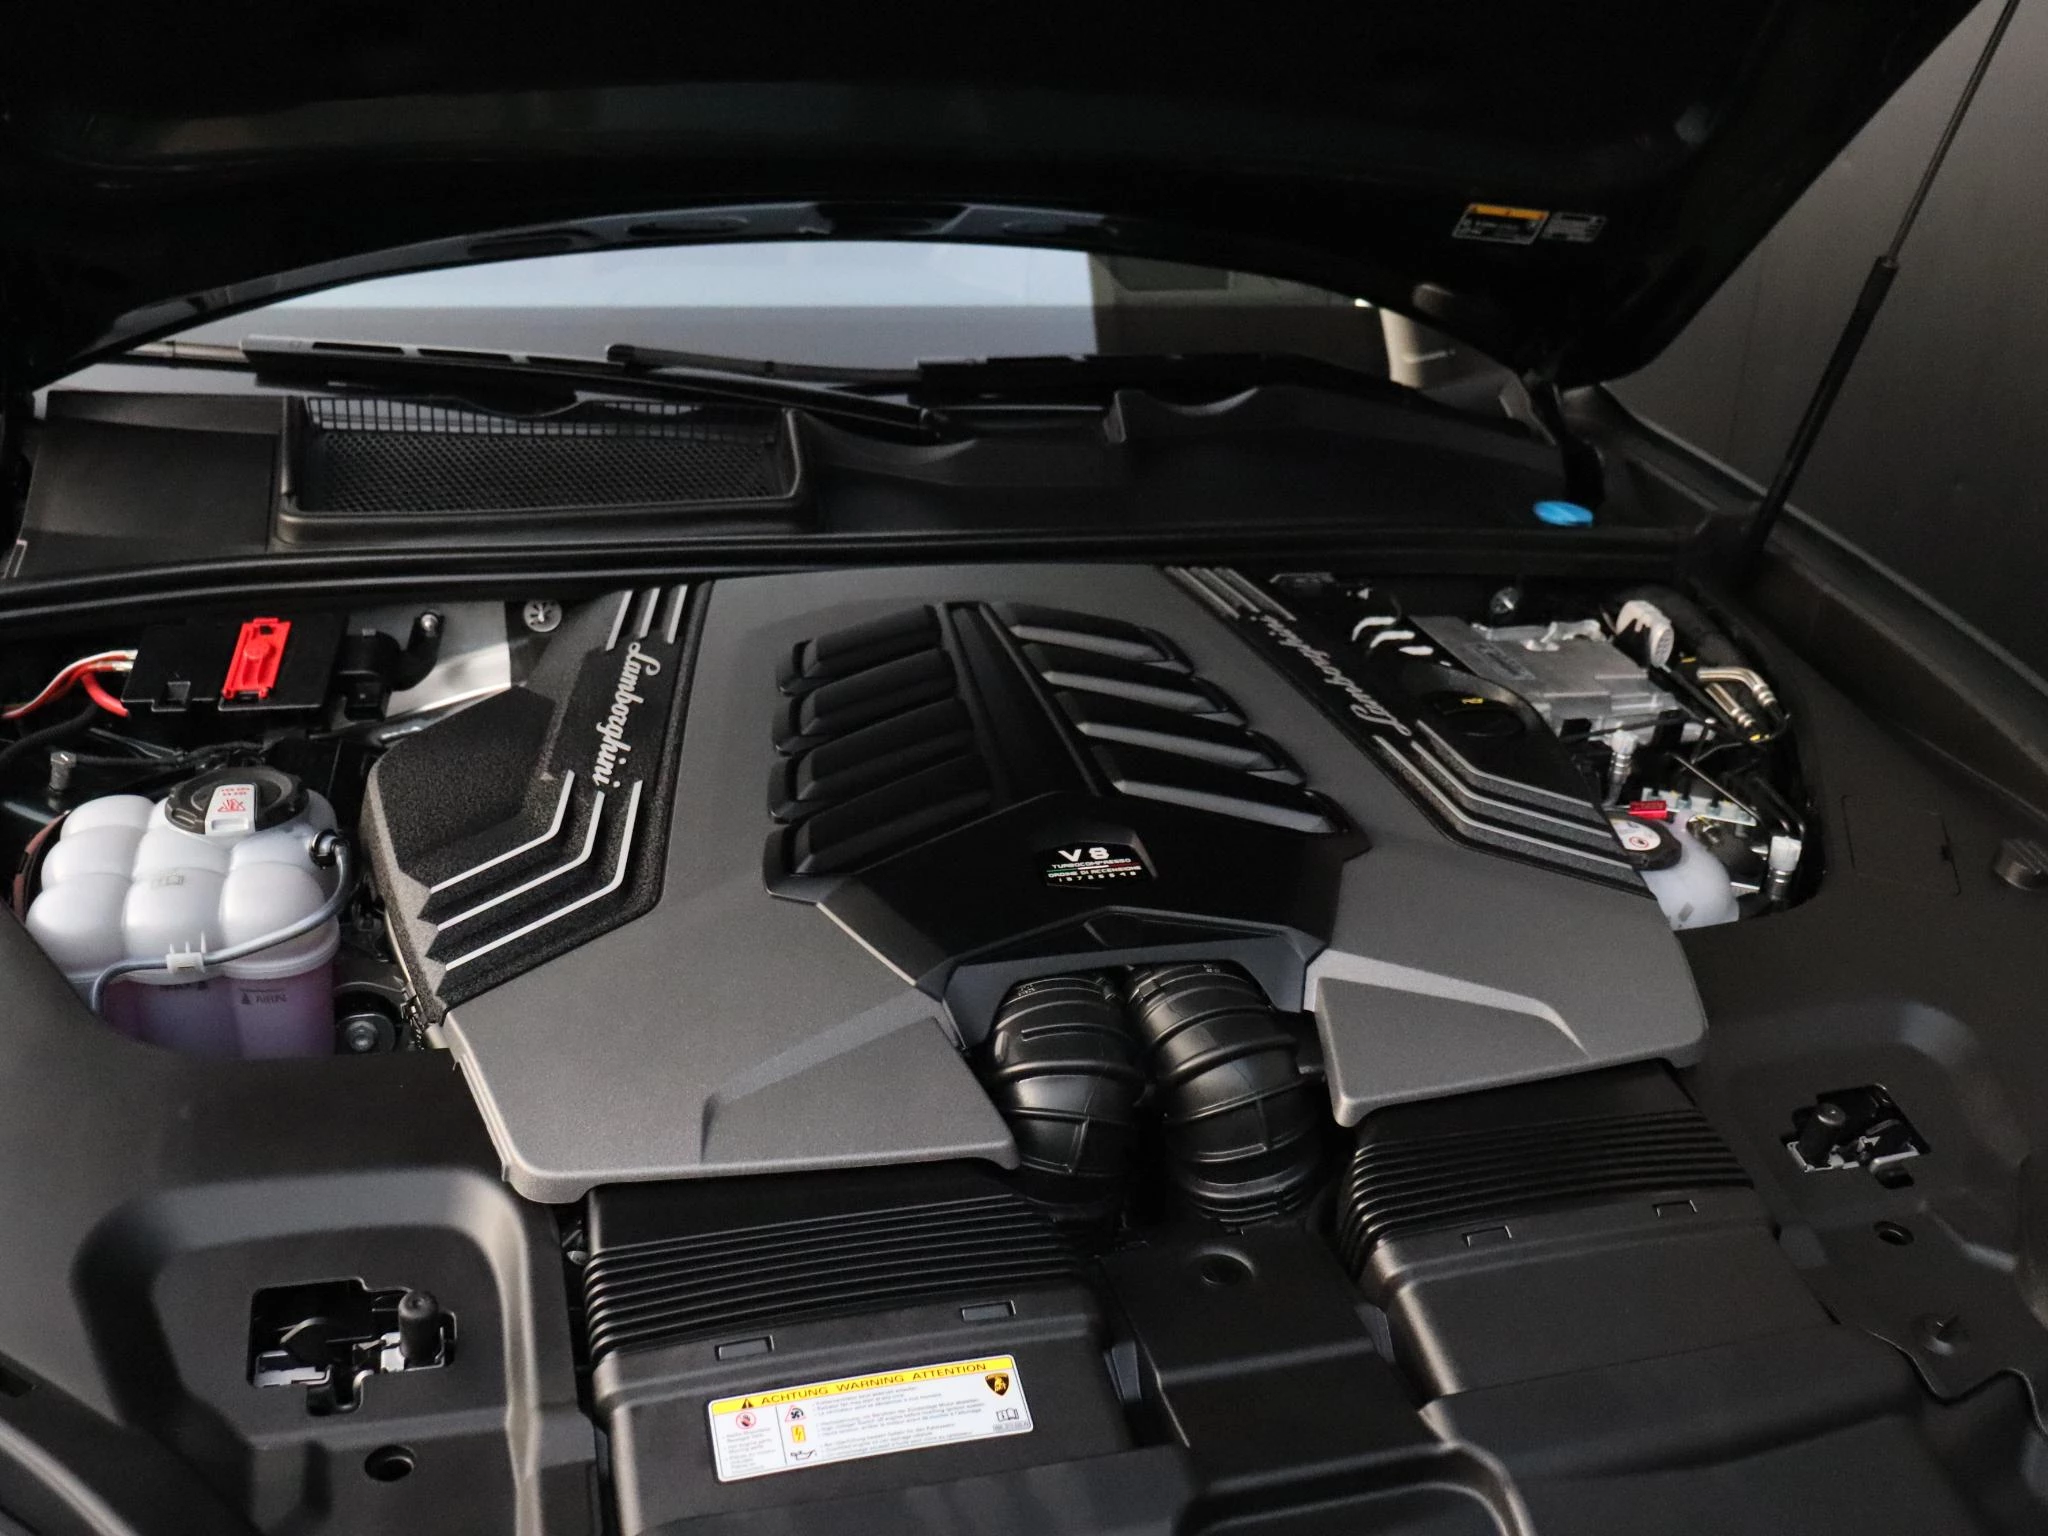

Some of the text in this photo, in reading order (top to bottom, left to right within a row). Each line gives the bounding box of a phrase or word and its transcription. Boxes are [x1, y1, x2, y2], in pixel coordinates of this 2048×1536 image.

[592, 642, 661, 788] Lamborghini
[1250, 615, 1412, 736] Lamborghini
[761, 1386, 829, 1405] ACHTUNG
[836, 1374, 905, 1393] WARNING
[912, 1362, 987, 1380] ATTENTION
